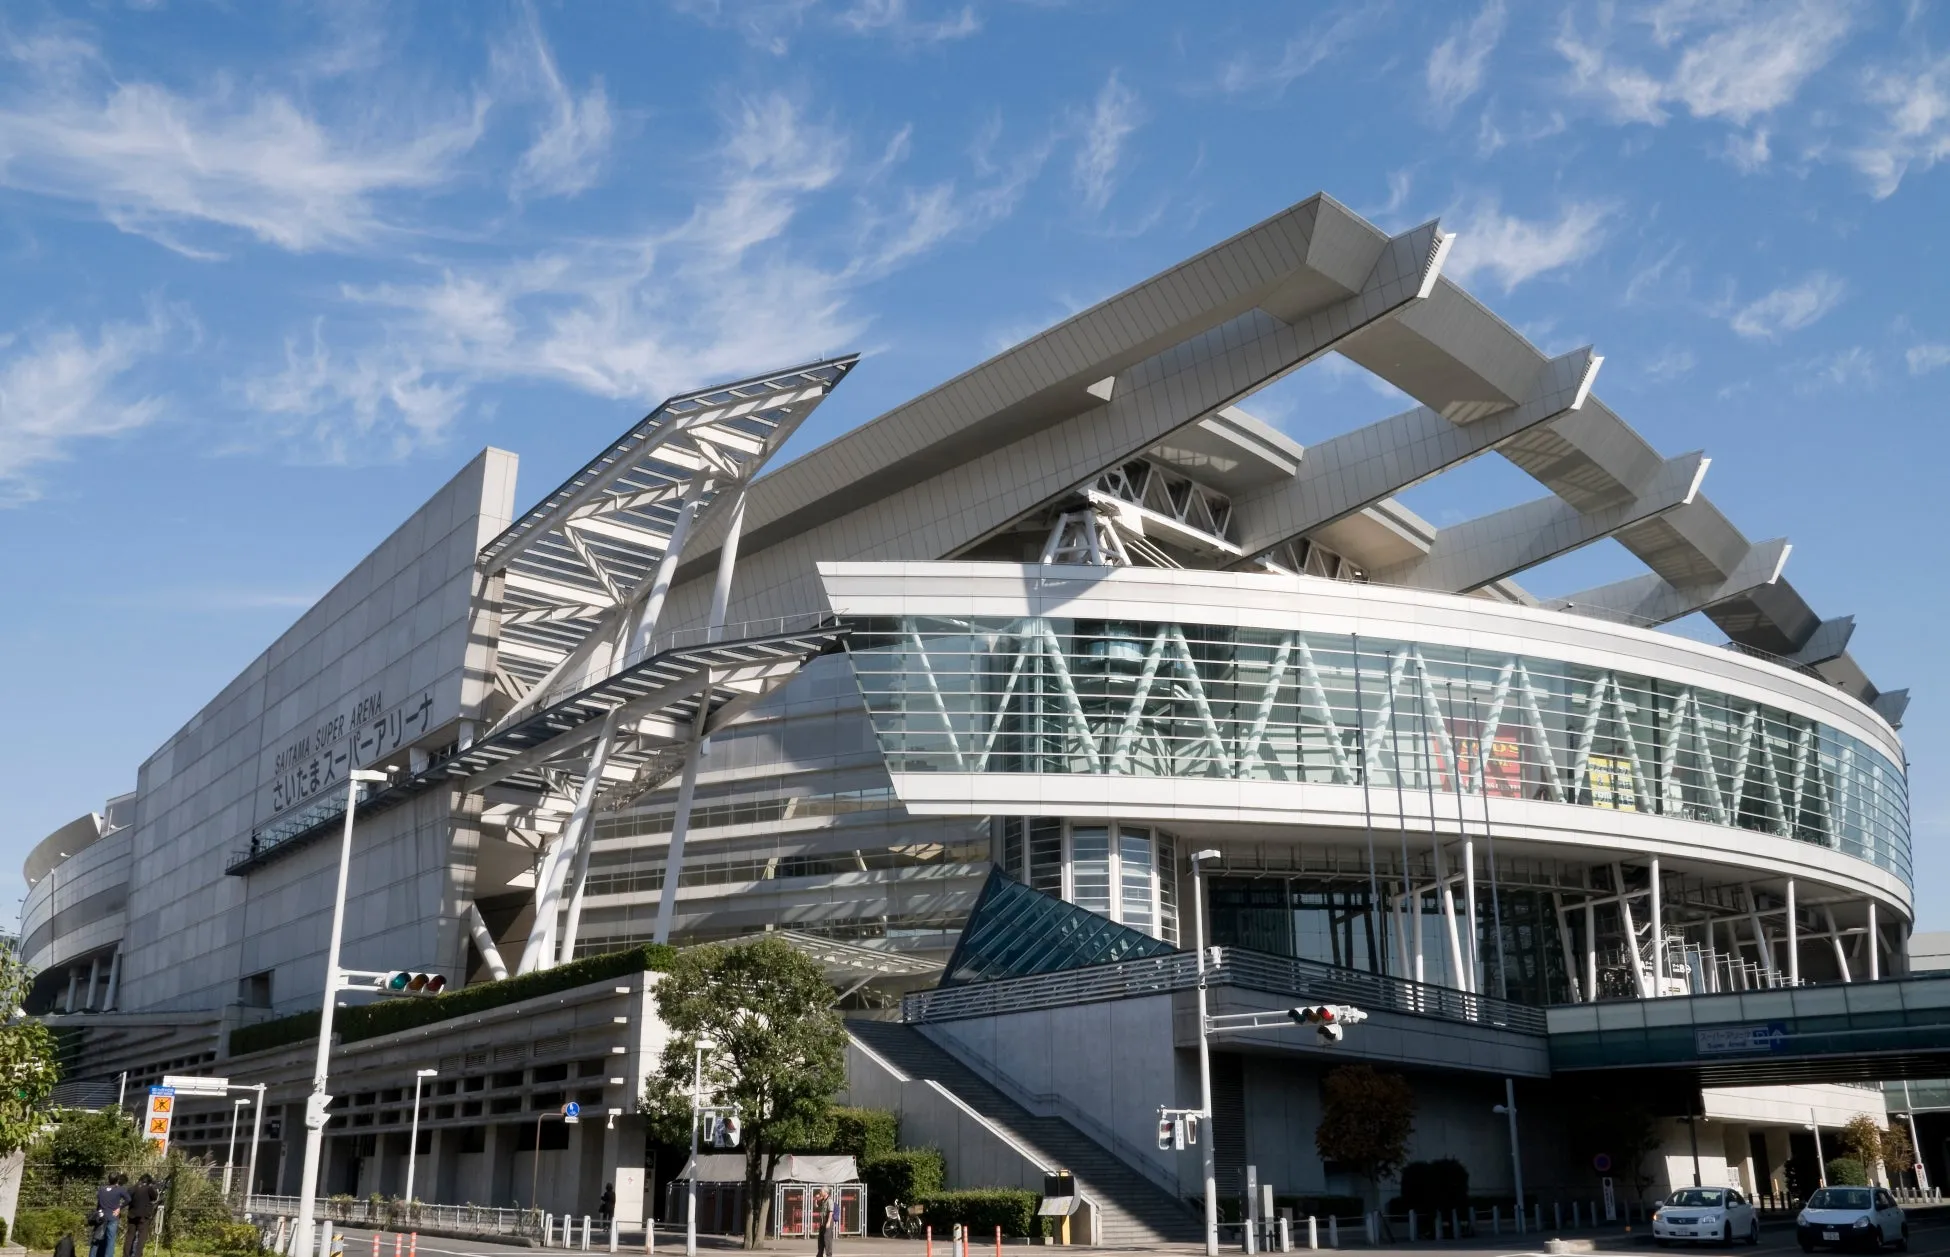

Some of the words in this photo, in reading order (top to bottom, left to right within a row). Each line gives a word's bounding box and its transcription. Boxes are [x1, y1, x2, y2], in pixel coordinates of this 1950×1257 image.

[273, 692, 433, 812] さいたまスーパーアリーナ
[275, 735, 310, 775] SAITAMA
[315, 714, 344, 750] SUPER
[350, 690, 382, 727] ARENA
